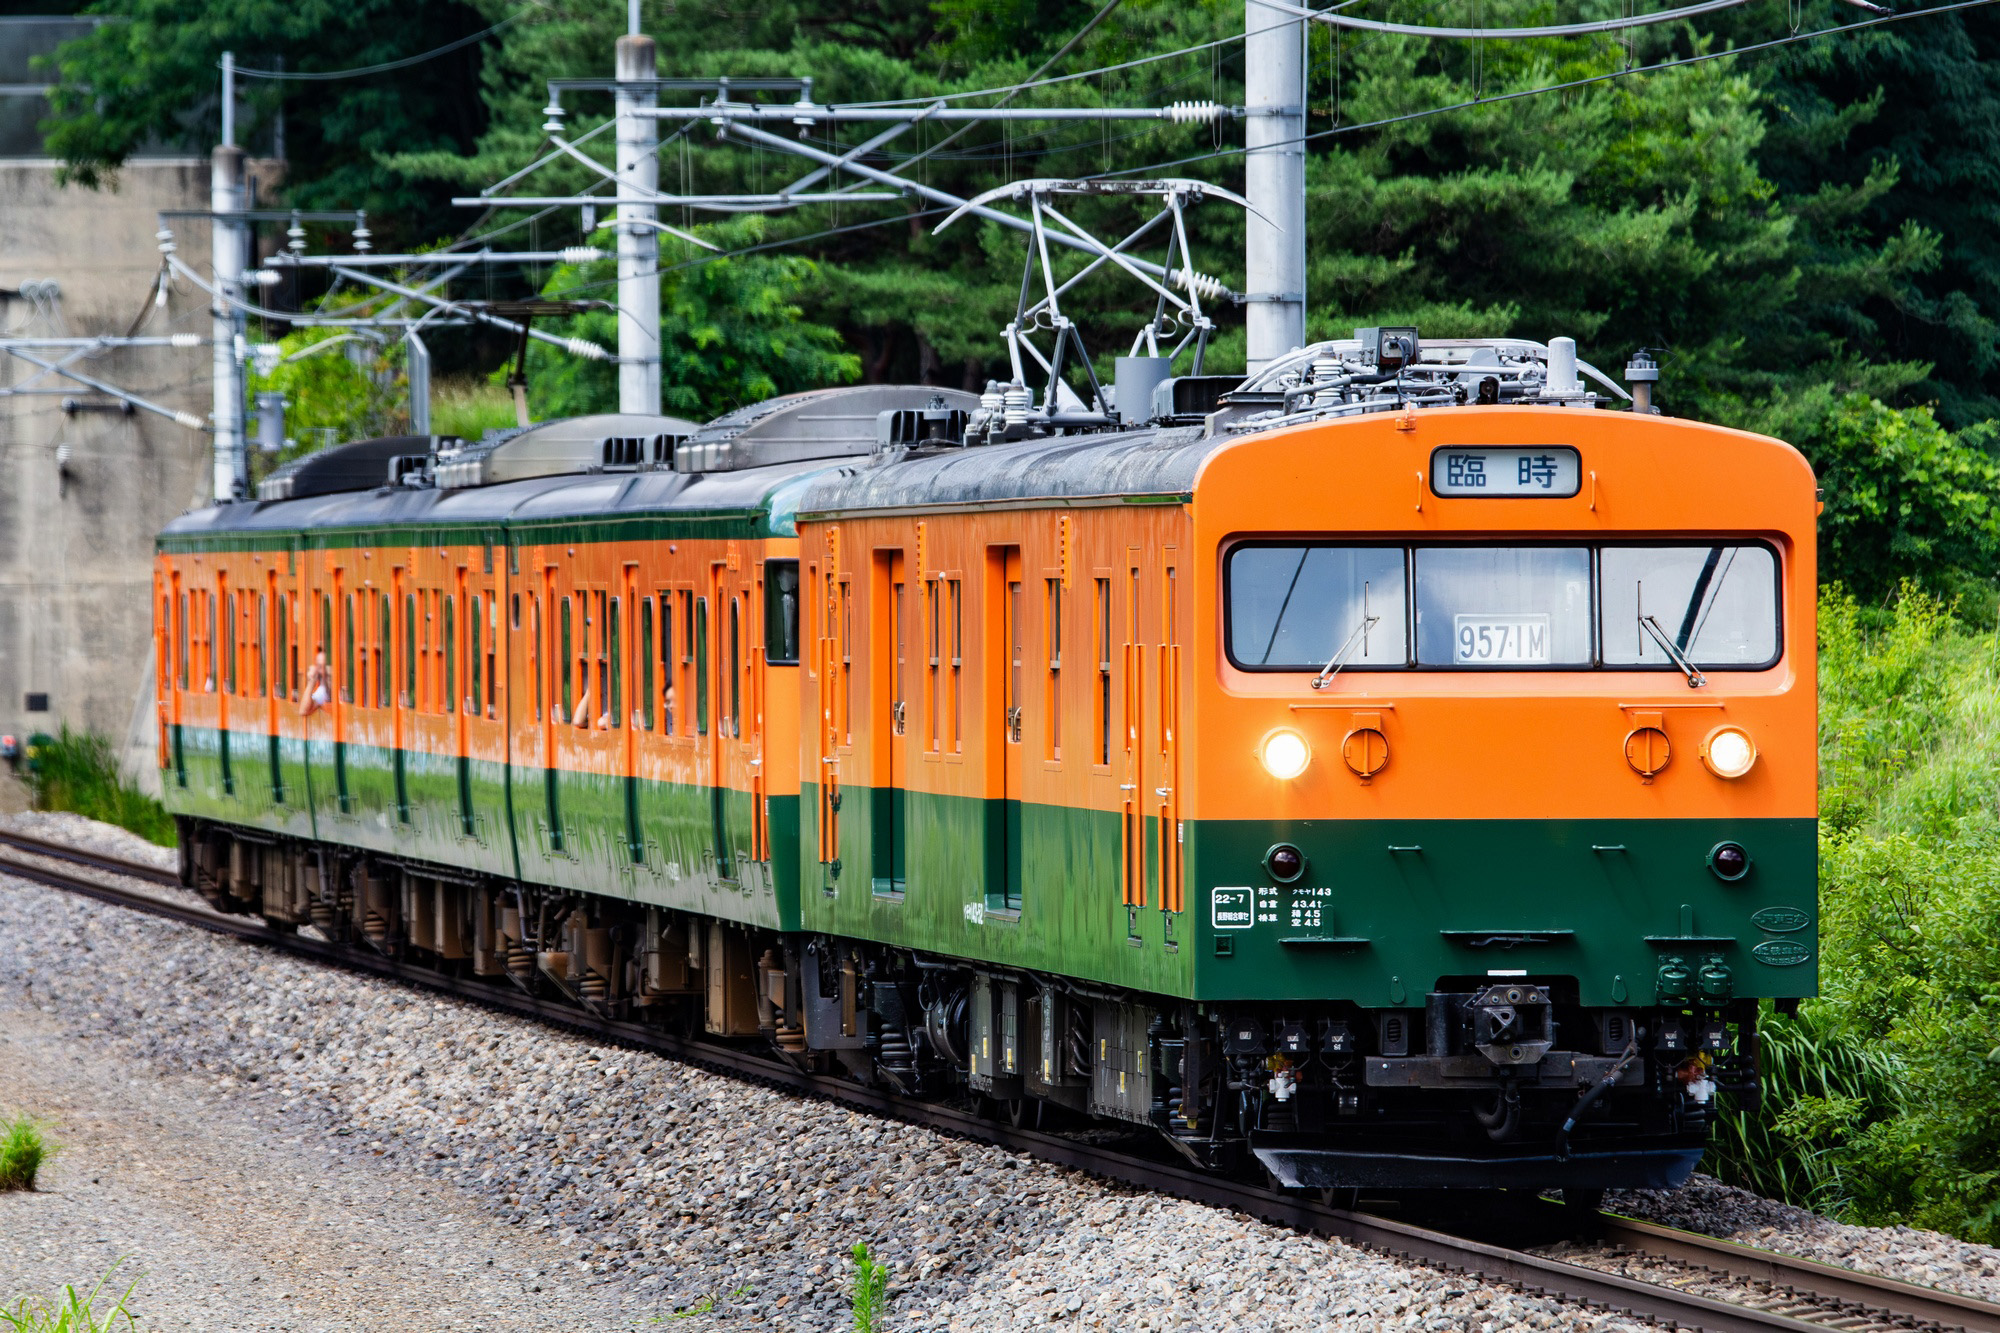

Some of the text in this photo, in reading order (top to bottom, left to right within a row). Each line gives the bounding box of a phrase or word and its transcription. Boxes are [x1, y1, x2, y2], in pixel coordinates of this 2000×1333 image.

[1447, 454, 1557, 488] 臨時
[1258, 887, 1278, 895] 形式
[1215, 894, 1244, 904] 22-7
[1304, 910, 1320, 918] 4.5
[1304, 918, 1320, 927] 4.5
